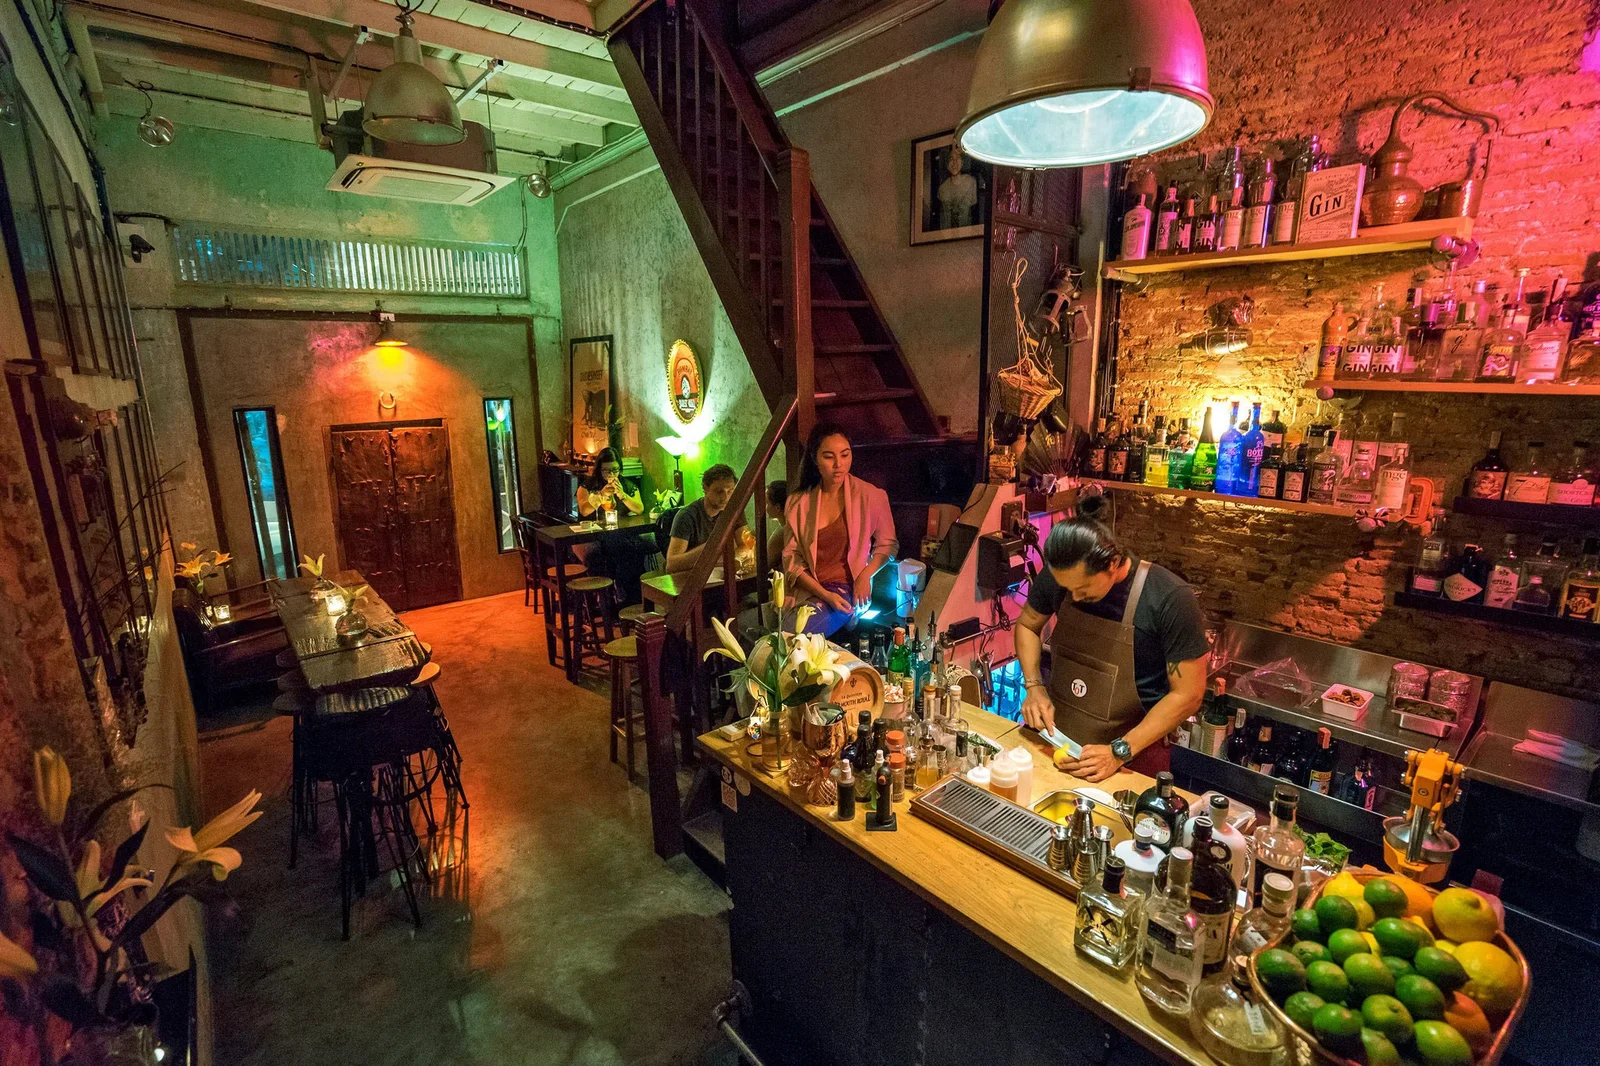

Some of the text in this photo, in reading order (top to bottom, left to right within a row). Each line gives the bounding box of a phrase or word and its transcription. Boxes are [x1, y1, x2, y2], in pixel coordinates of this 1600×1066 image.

[1309, 194, 1343, 217] GIN
[1346, 345, 1371, 354] GIN
[1373, 344, 1398, 353] GIN
[1342, 363, 1369, 372] GIN
[1370, 364, 1395, 373] GIN
[1382, 471, 1406, 481] mgc
